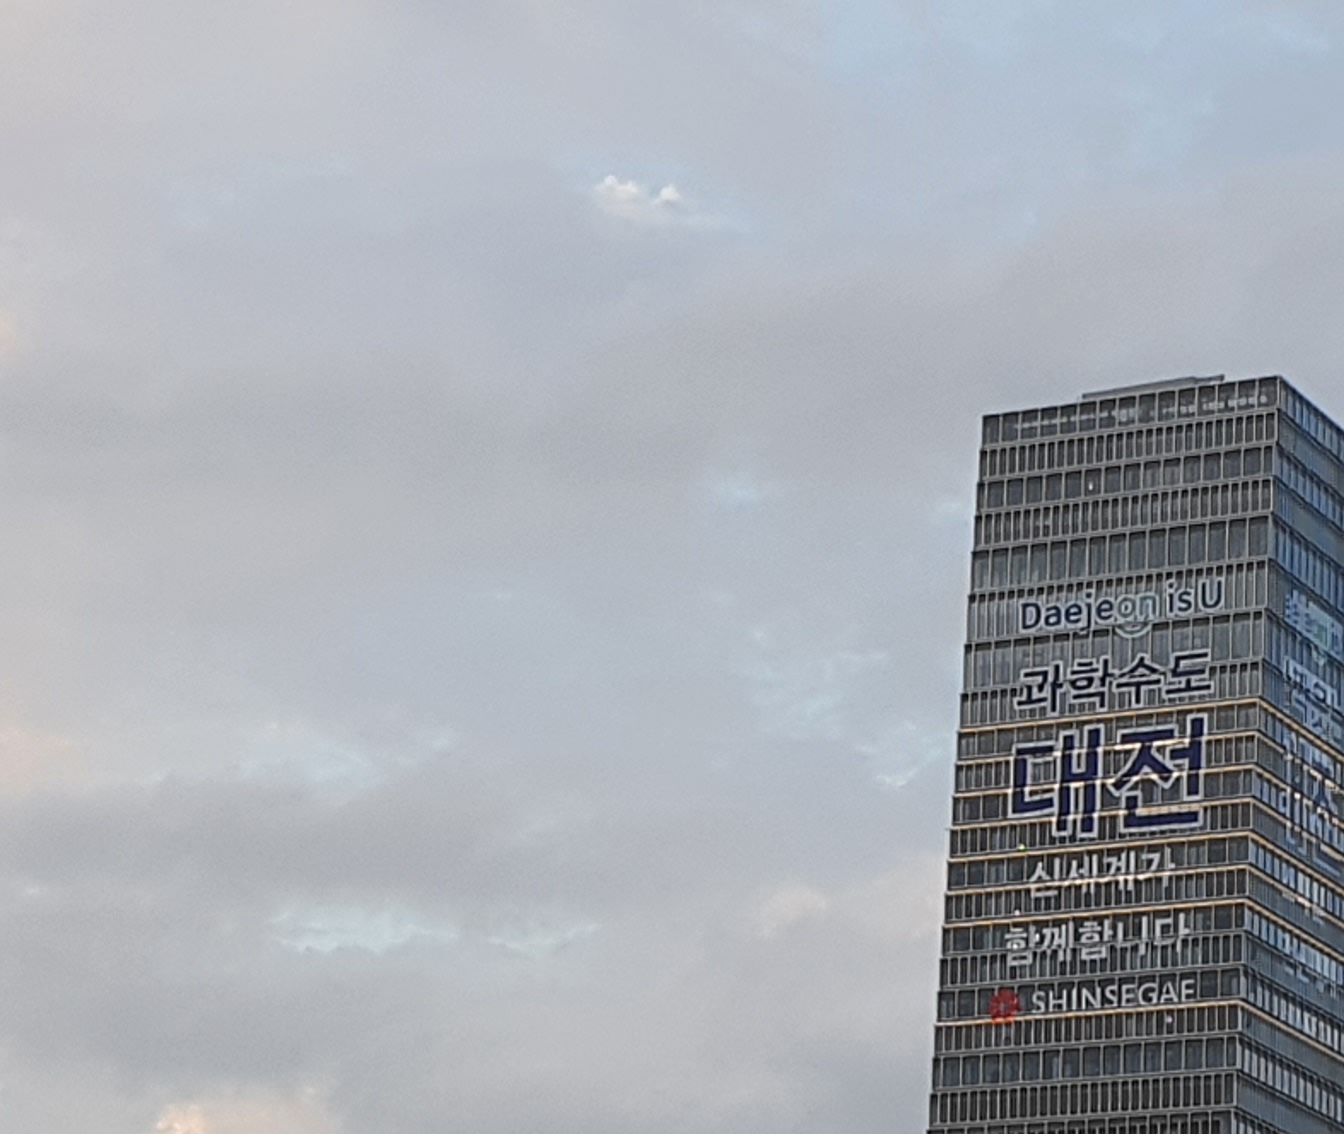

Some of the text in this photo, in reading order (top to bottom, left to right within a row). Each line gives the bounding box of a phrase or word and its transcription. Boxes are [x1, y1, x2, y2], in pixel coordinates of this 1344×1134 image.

[1019, 578, 1224, 634] Daejeon is U
[1014, 650, 1213, 714] 과학수도
[1010, 714, 1207, 837] 대전
[1028, 846, 1176, 898] 신세계가
[1004, 911, 1191, 967] 함께합니다
[1031, 979, 1196, 1014] SHINSEGAE
